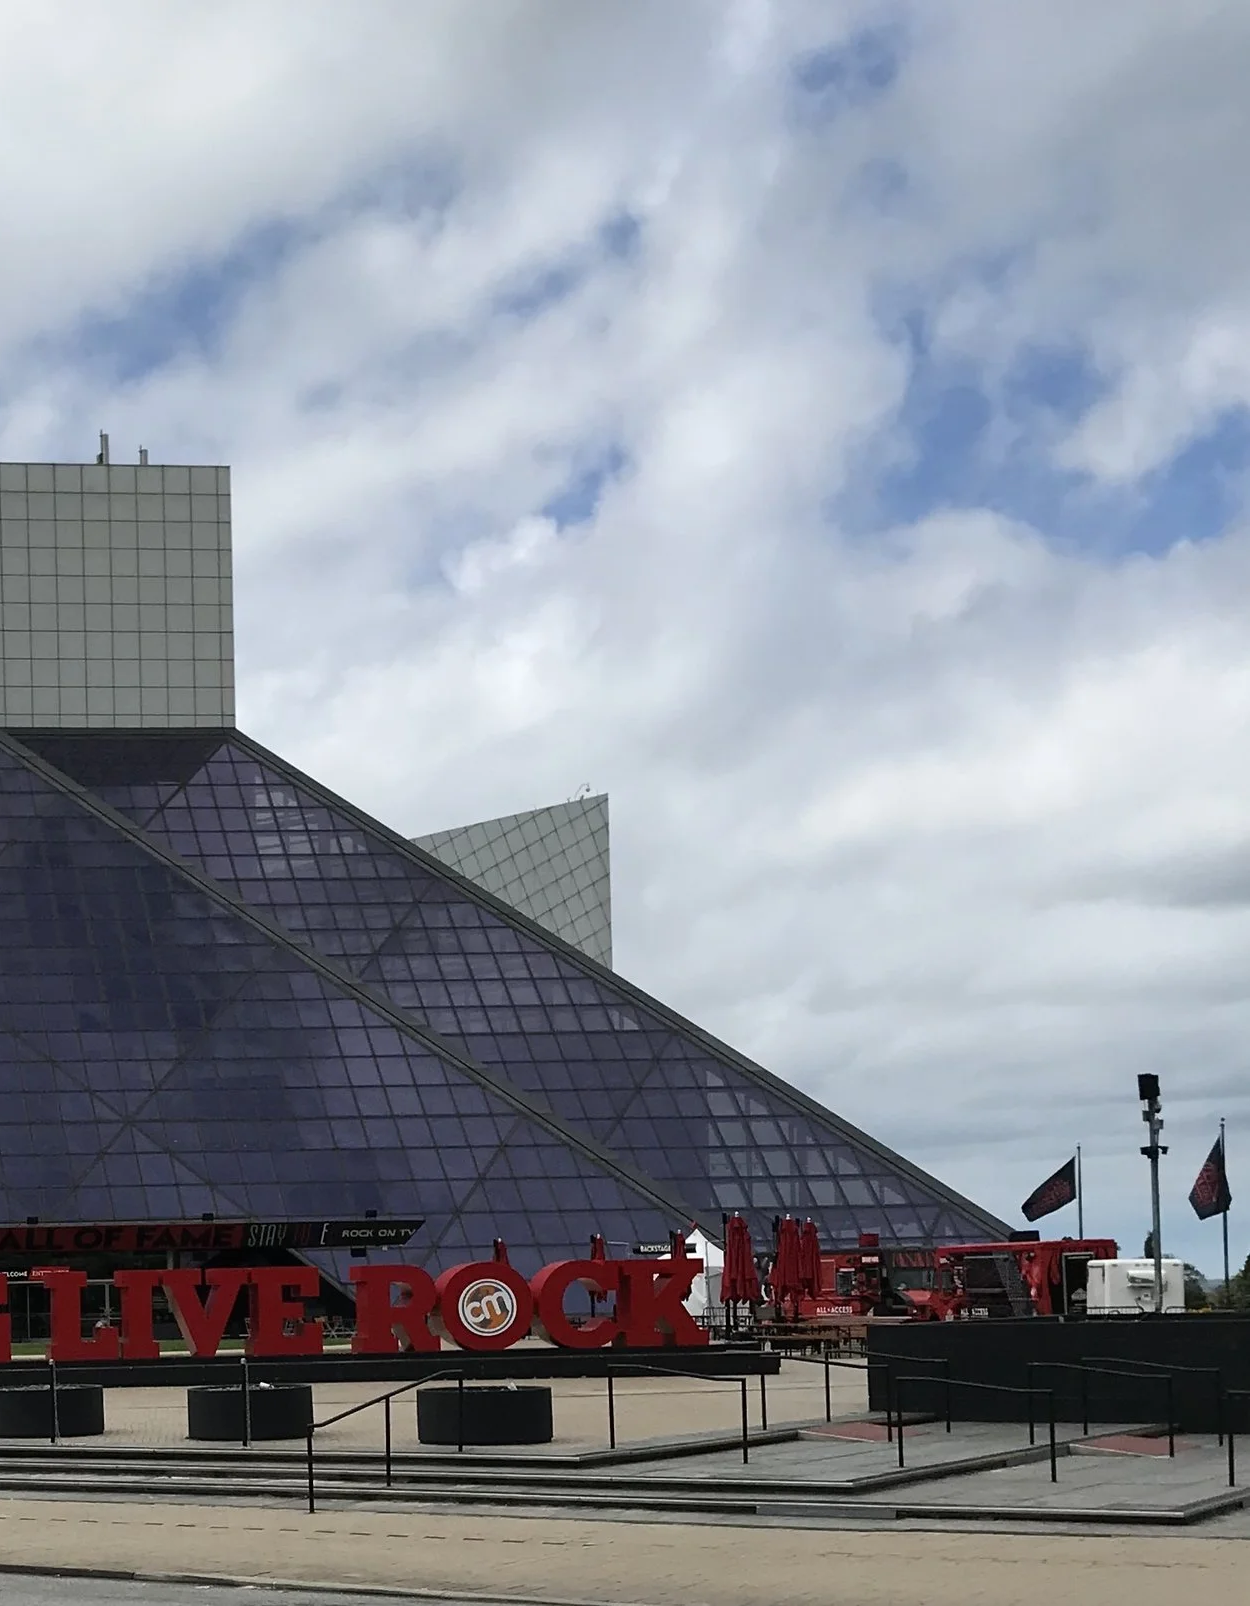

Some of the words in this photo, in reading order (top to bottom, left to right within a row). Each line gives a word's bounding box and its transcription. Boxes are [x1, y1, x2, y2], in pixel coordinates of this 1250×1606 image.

[74, 1227, 127, 1249] OF
[137, 1225, 233, 1249] FAME
[248, 1223, 287, 1247] STAY
[342, 1229, 373, 1238] ROCK
[378, 1229, 396, 1237] ON
[399, 1228, 417, 1237] TV
[44, 1266, 324, 1362] LIVE
[350, 1258, 710, 1353] ROCK
[466, 1290, 511, 1323] cm
[831, 1305, 853, 1314] ACCESS
